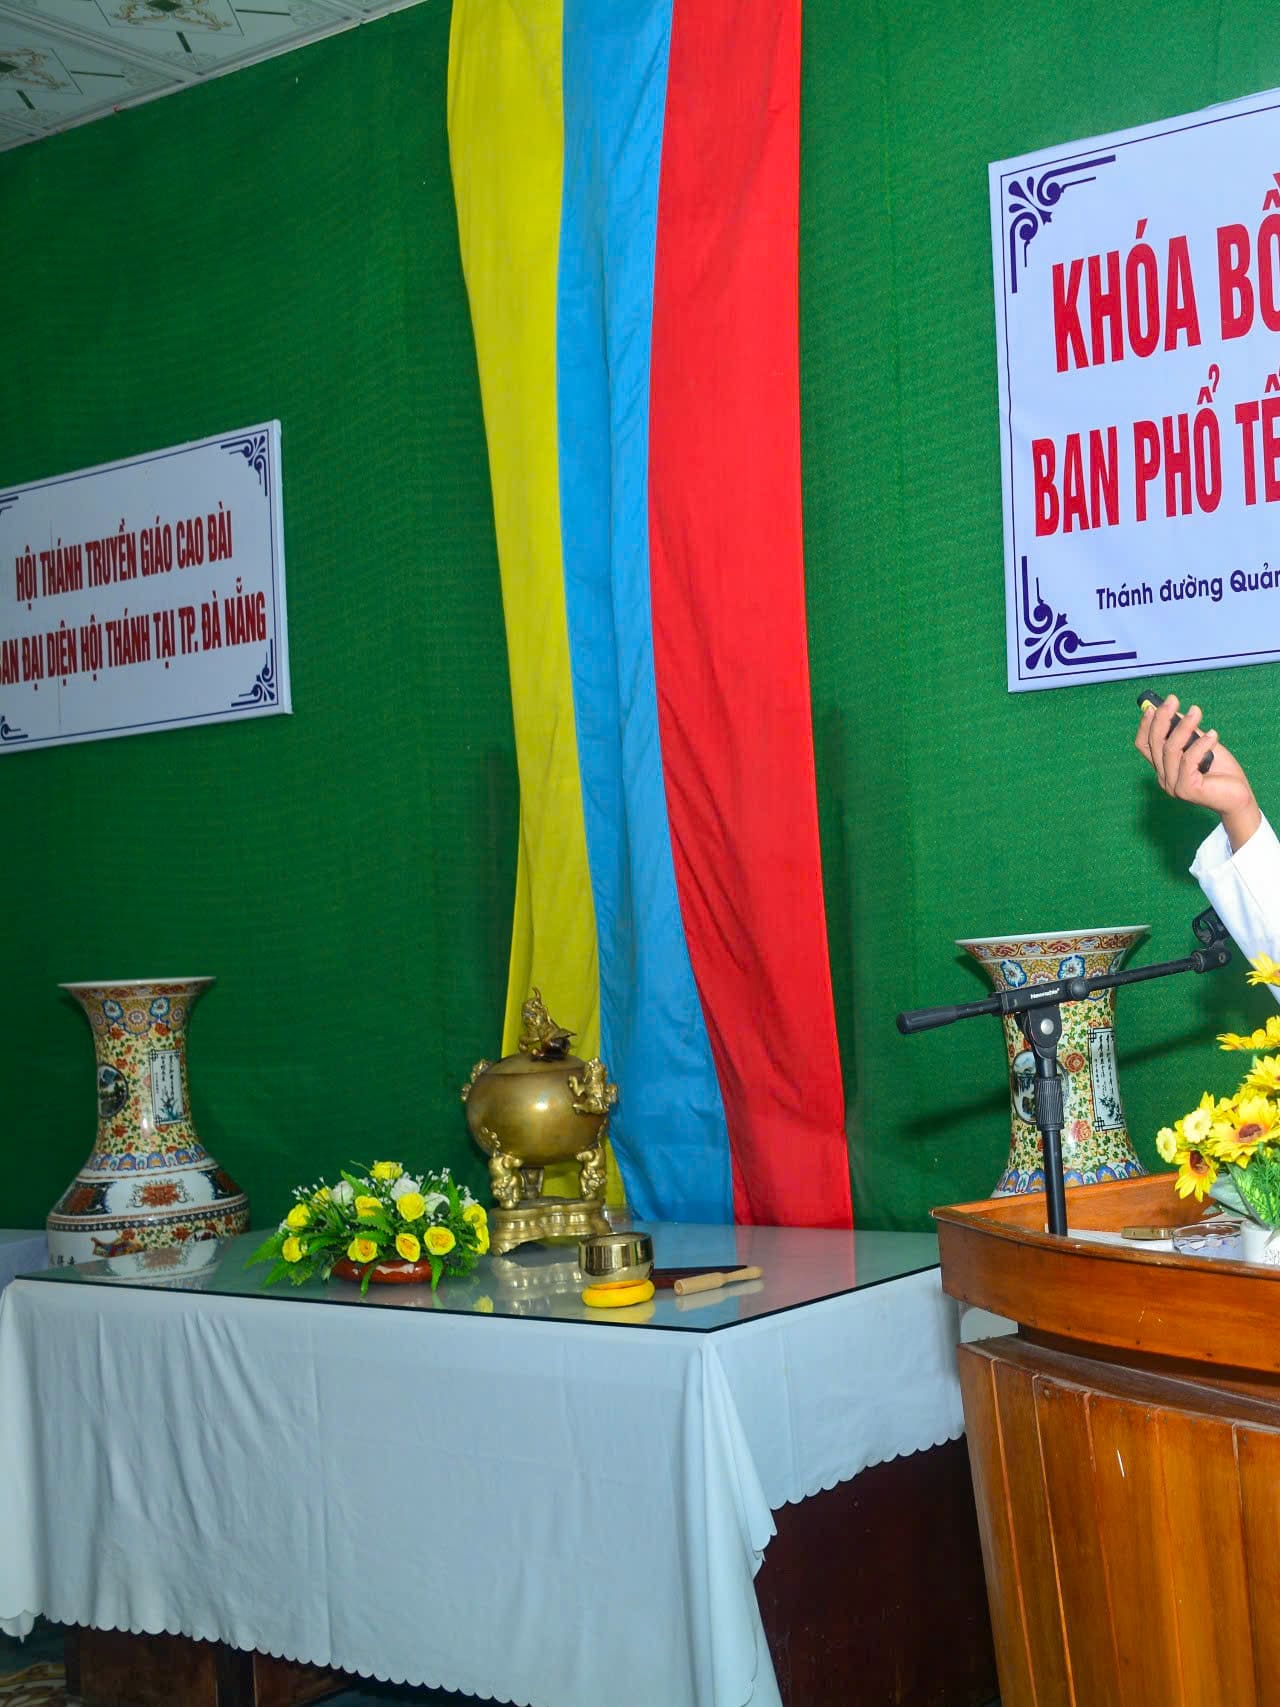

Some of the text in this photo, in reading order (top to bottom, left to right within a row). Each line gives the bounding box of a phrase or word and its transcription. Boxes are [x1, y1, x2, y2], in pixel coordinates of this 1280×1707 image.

[1052, 219, 1201, 373] KHÓA
[1031, 426, 1120, 537] BAN
[1133, 364, 1223, 522] PHỔ
[15, 500, 233, 611] HỘI THÁNH TRUYỀN GIÁO CAO ĐÀI
[1096, 582, 1154, 610] Thánh
[1159, 574, 1223, 603] đường
[0, 576, 267, 692] AN ĐẠI DIỆN HỘI THÁNH TẠI TP. ĐÀ NẴNG
